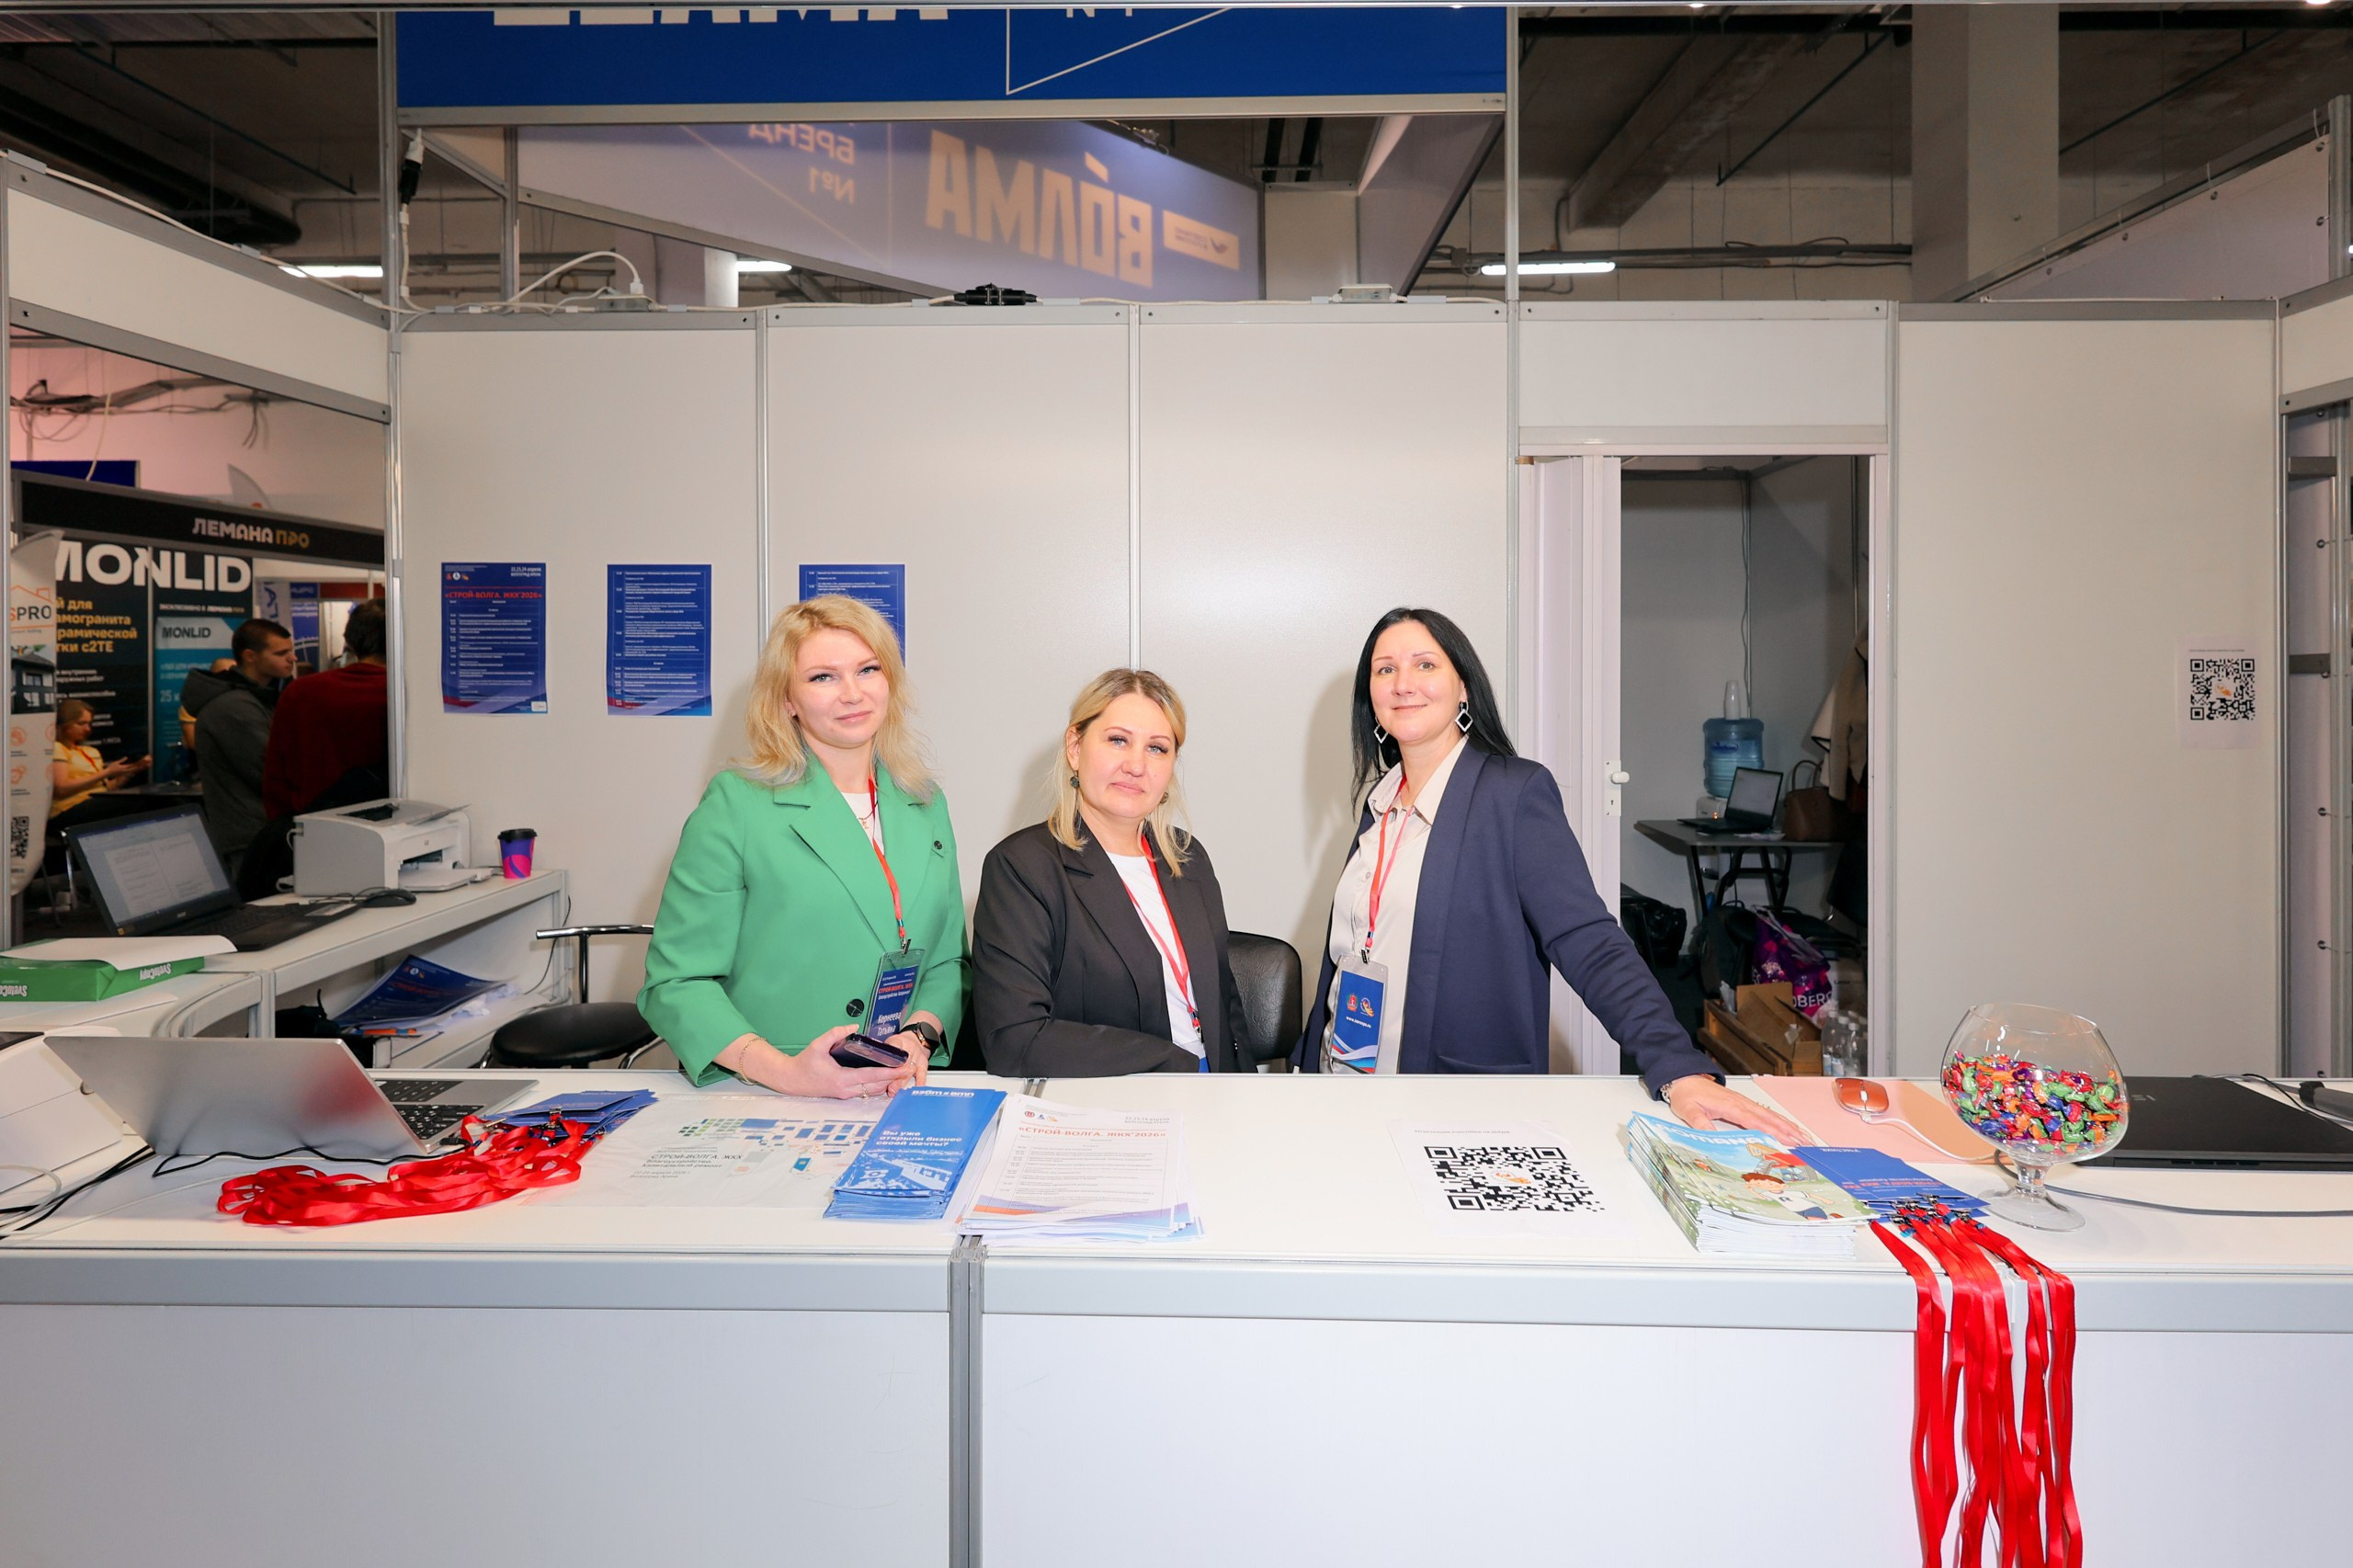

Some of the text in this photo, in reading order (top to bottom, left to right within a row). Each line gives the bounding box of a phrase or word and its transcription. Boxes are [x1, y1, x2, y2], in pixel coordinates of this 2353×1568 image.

[192, 517, 310, 548] ЛЕМАНА ПРО
[67, 599, 93, 611] для
[162, 626, 211, 639] MONLID
[160, 690, 172, 703] 25
[140, 963, 172, 981] SvetoCopy
